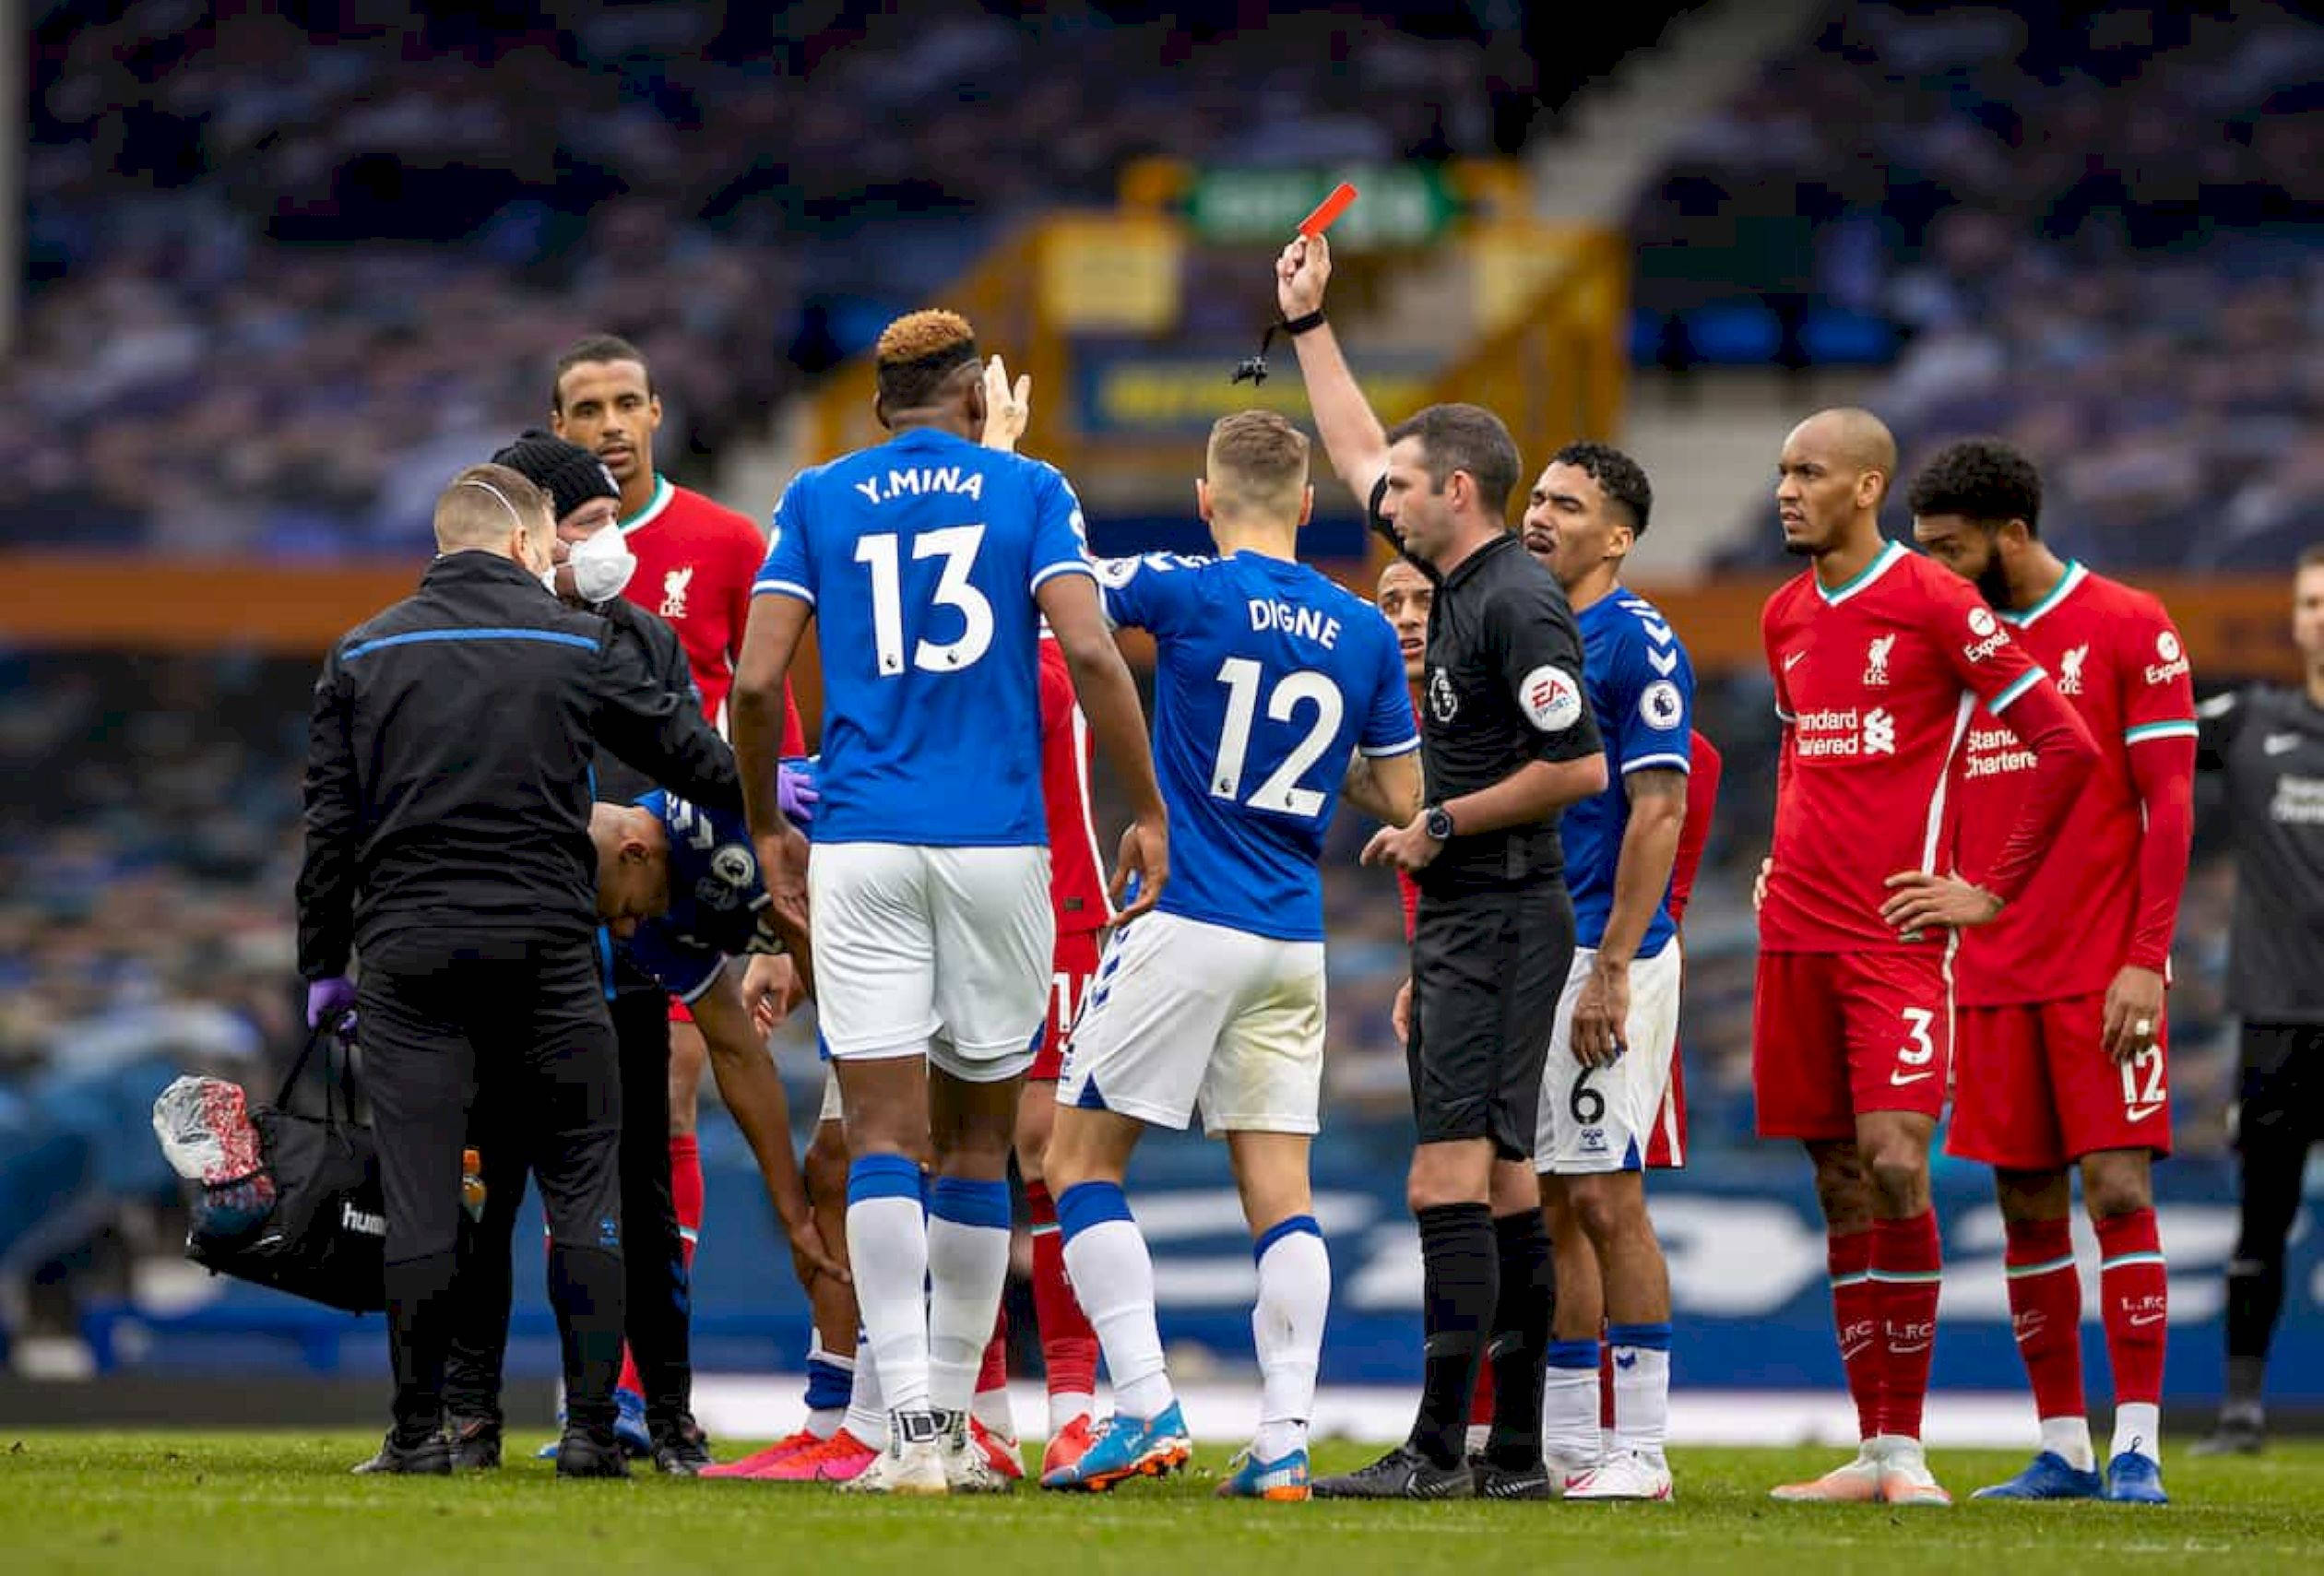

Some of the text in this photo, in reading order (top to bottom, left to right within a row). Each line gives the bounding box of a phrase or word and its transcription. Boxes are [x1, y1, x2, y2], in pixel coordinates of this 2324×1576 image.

[855, 466, 984, 504] Y.MINA
[854, 523, 995, 678] 13
[1248, 599, 1342, 651] DIGNE
[1210, 657, 1345, 817] 12
[1898, 1006, 1935, 1065] 3
[1571, 1066, 1606, 1126] 6
[2121, 1043, 2167, 1103] 12
